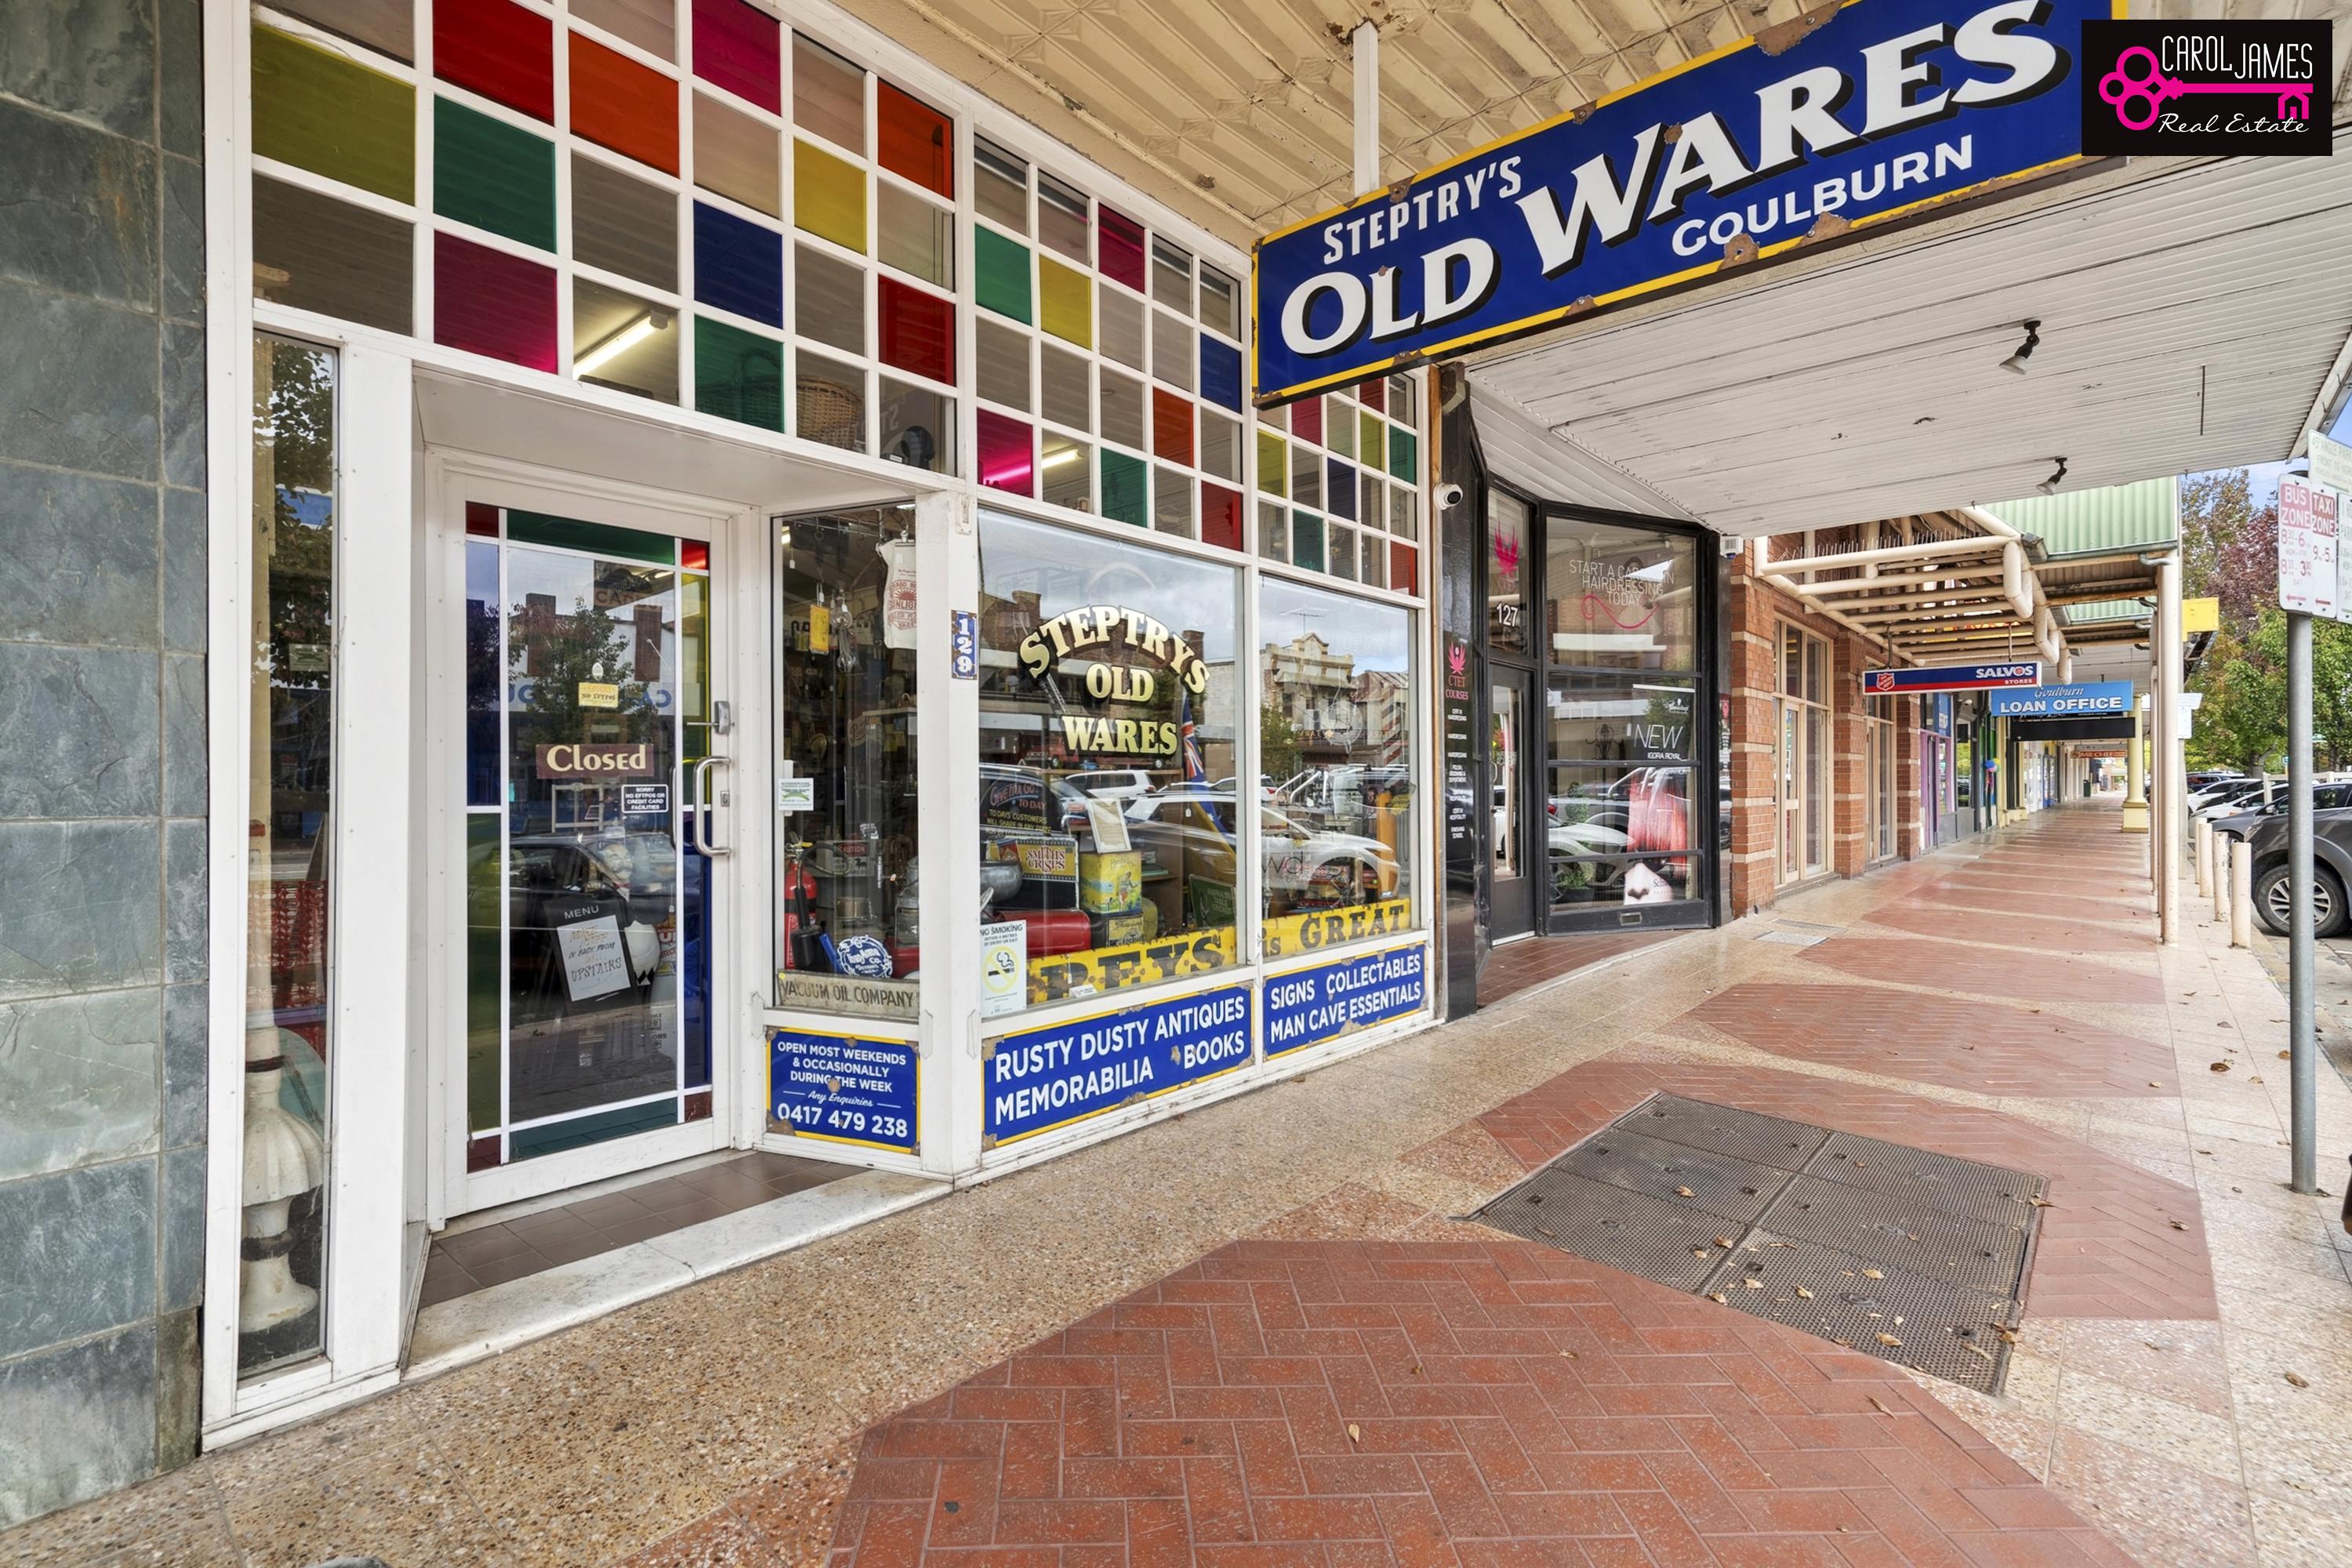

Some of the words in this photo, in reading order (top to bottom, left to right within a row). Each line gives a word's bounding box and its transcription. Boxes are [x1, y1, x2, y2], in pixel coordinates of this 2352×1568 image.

[1281, 237, 1499, 356] OLD
[1515, 0, 2062, 278] WARES
[1671, 134, 1974, 257] GOULBURN
[1323, 155, 1522, 265] STEPTRY'S
[2284, 486, 2307, 506] BUS
[2313, 494, 2334, 515] TAXI
[2281, 507, 2310, 527] ZONE
[2312, 514, 2335, 536] ZONE
[1569, 559, 1603, 577] START
[1607, 564, 1615, 578] A
[1582, 575, 1664, 597] HAIRDRESSING
[888, 600, 916, 612] SUNLIG
[1607, 591, 1641, 607] TODAY
[1496, 602, 1519, 627] 127
[956, 618, 973, 673] 129
[1019, 604, 1212, 695] STEPTRYS
[1085, 662, 1155, 702] OLD
[1975, 665, 2034, 679] SALVOS
[2000, 699, 2046, 713] LOAN
[2052, 695, 2123, 711] OFFICE
[2034, 686, 2084, 699] Goulburn
[1062, 714, 1178, 756] WARES
[1633, 724, 1684, 750] NEW
[546, 744, 646, 772] Closed
[1028, 858, 1066, 873] CRISPS
[564, 905, 600, 920] MENU
[991, 923, 1024, 935] SMOKING
[1299, 904, 1404, 949] GREAT
[1261, 927, 1282, 958] is
[571, 956, 622, 982] UPSTAIRS
[782, 979, 829, 1000] VACUUM
[833, 985, 851, 1002] OIL
[853, 986, 913, 1007] COMPANY
[1270, 978, 1316, 1011] SIGNS
[1326, 953, 1421, 995] COLLECTABLES
[1270, 1012, 1305, 1044] MAN
[1308, 1000, 1346, 1031] CAVE
[1349, 980, 1421, 1020] ESSENTIALS
[996, 1036, 1074, 1083] RUSTY
[1080, 1018, 1150, 1061] DUSTY
[1153, 995, 1245, 1042] ANTIQUES
[777, 1041, 807, 1054] OPEN
[809, 1045, 840, 1058] MOST
[842, 1048, 906, 1065] WEEKENDS
[793, 1057, 800, 1068] &
[802, 1058, 890, 1078] OCCASIONALLY
[995, 1055, 1154, 1126] MEMORABILIA
[1183, 1029, 1245, 1070] BOOKS
[789, 1071, 832, 1084] DURING
[834, 1076, 857, 1088] THE
[858, 1079, 893, 1093] WEEK
[808, 1091, 827, 1103] Any
[828, 1093, 873, 1107] Enquiries
[777, 1103, 822, 1125] 0417
[827, 1109, 866, 1131] 479
[871, 1115, 908, 1138] 238
